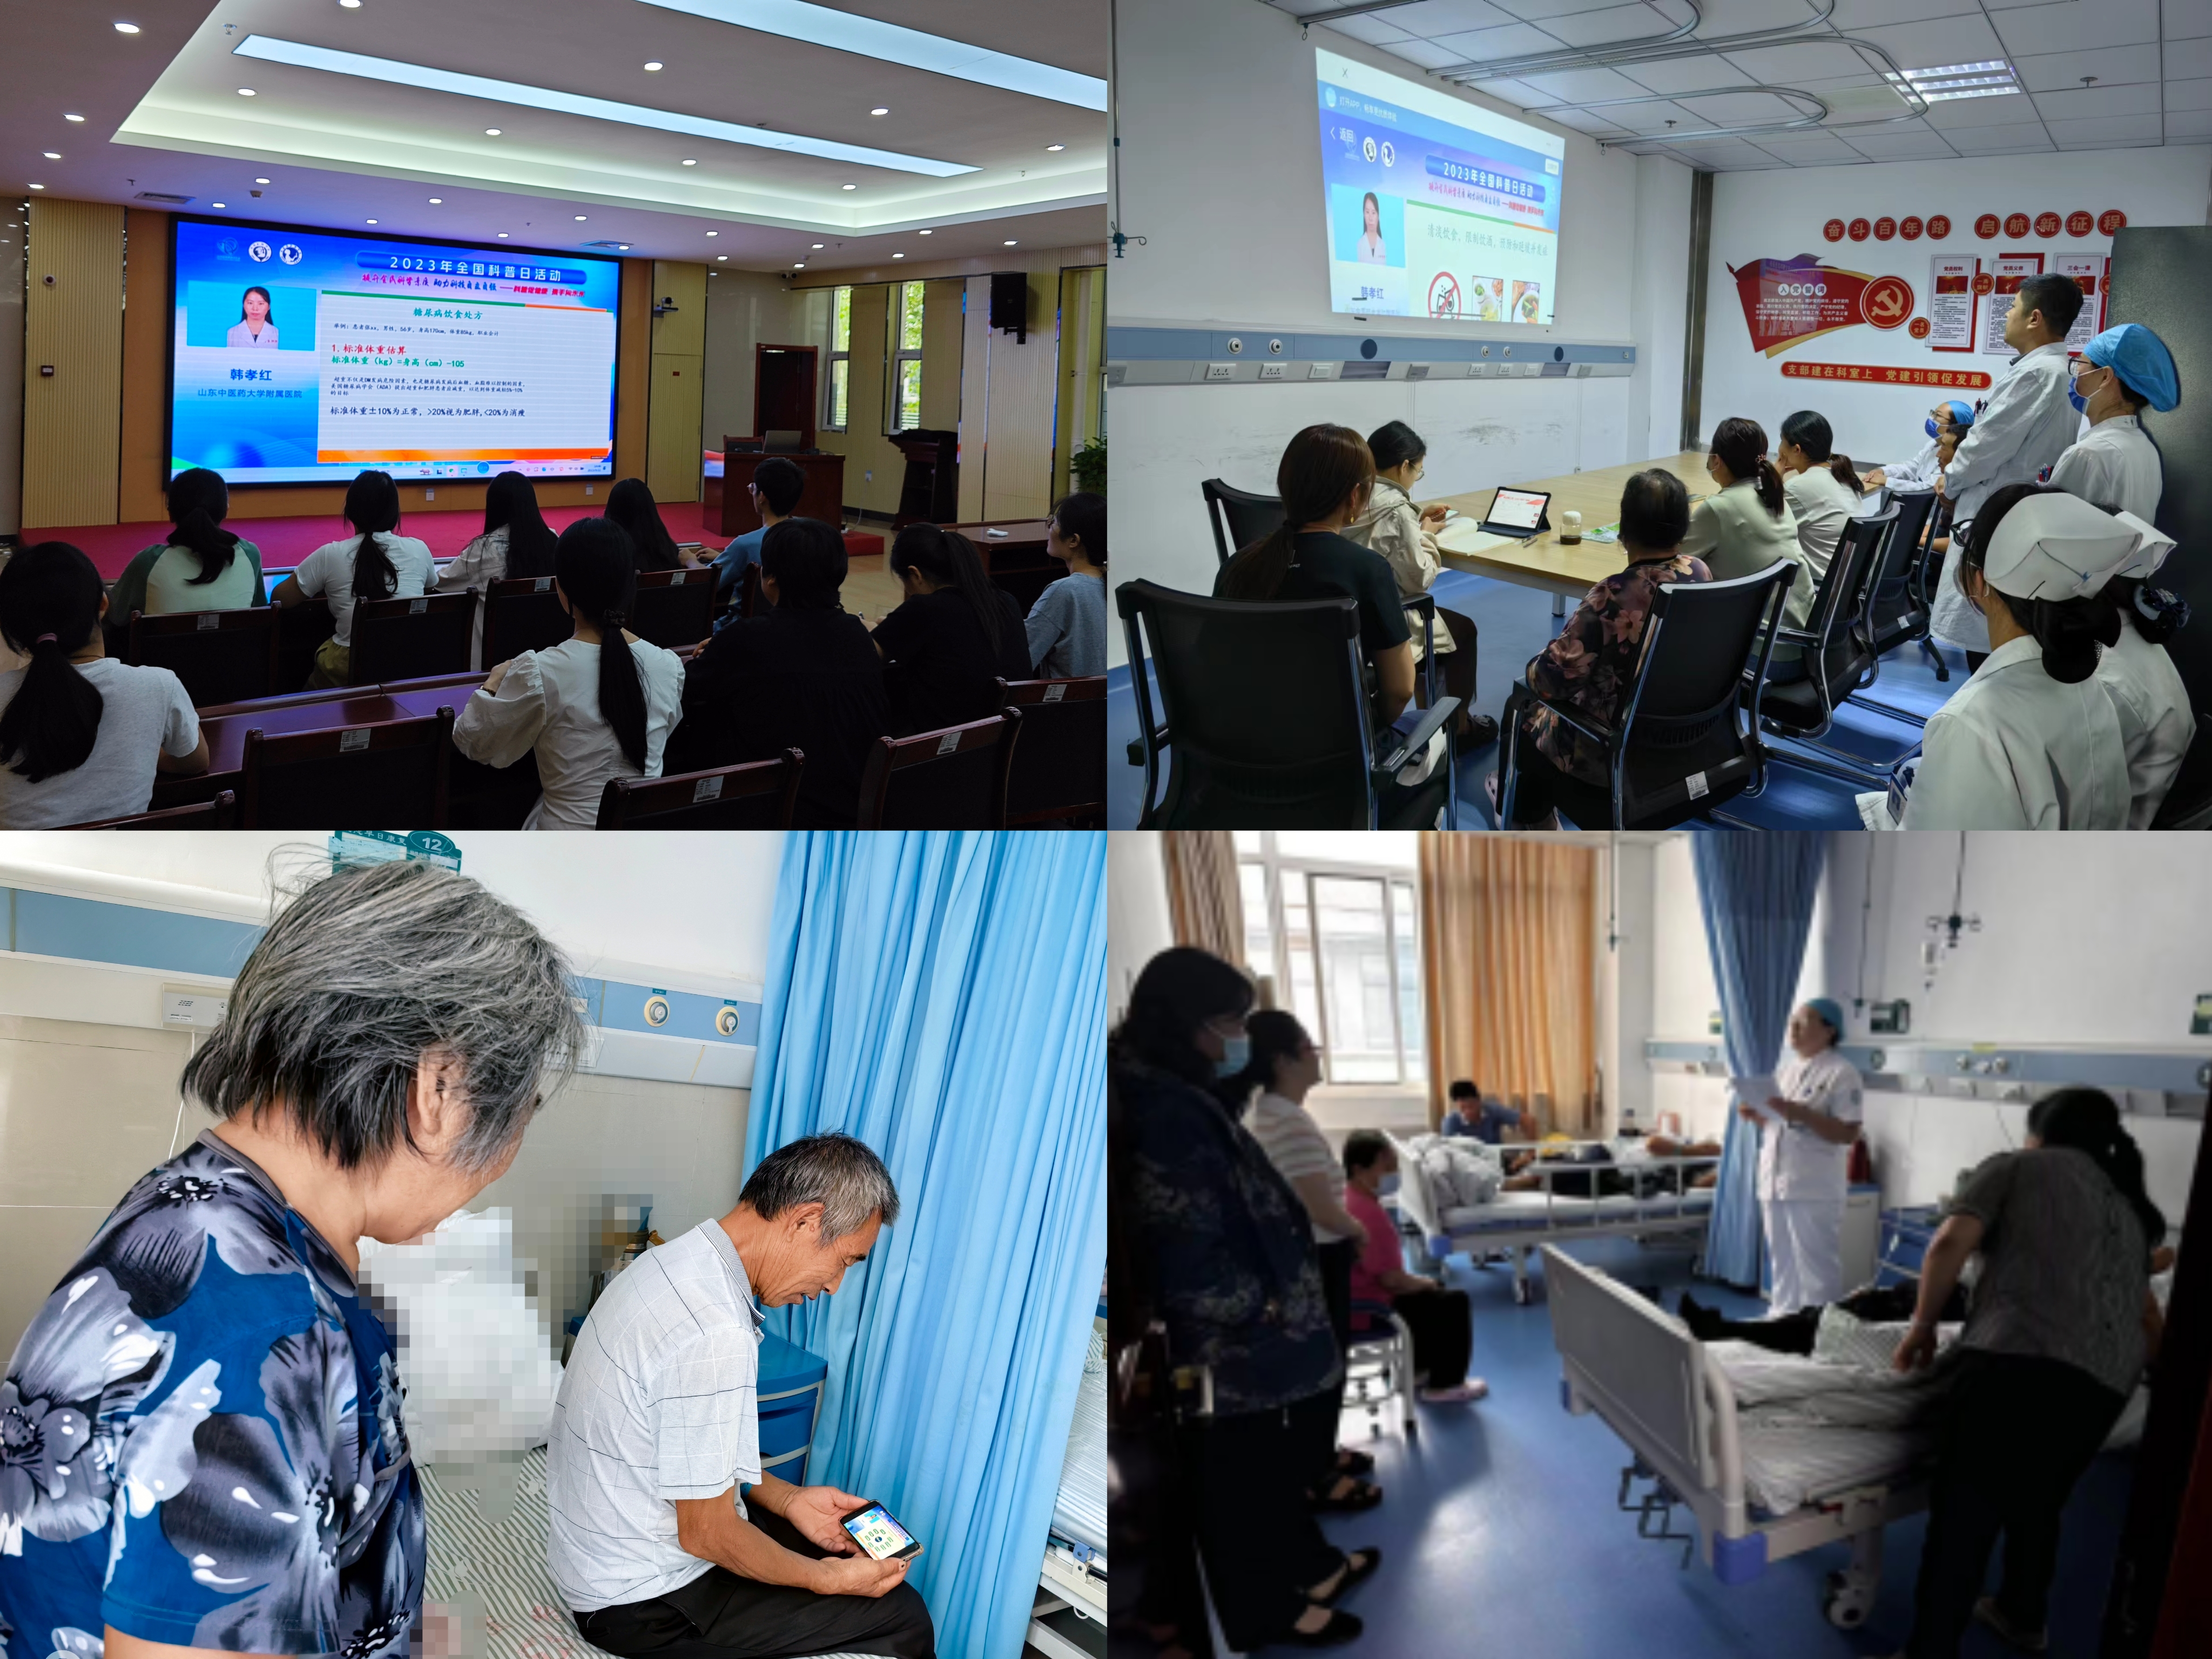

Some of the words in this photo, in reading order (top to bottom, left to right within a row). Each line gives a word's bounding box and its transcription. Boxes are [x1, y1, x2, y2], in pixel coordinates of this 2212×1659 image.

[1339, 127, 1354, 143] 返回
[1444, 162, 1533, 198] 2023年全国科普日活动
[1827, 220, 1945, 237] 奋斗百年路
[1980, 214, 2120, 234] 启航新征程
[390, 257, 561, 282] 2023年全国科普日活动
[362, 273, 430, 287] 提升全民科学素质
[433, 278, 497, 292] 助力科技自立自强
[1779, 285, 1825, 294] 入党誓词
[1360, 286, 1384, 300] 韩孝红
[413, 307, 483, 320] 糖尿病饮食处方
[230, 368, 272, 381] 韩孝红
[1787, 365, 1873, 379] 支部建在科室上
[1886, 369, 1982, 387] 党建引领促发展
[198, 388, 302, 399] 山东中医药大学附属医院
[422, 837, 442, 851] 12
